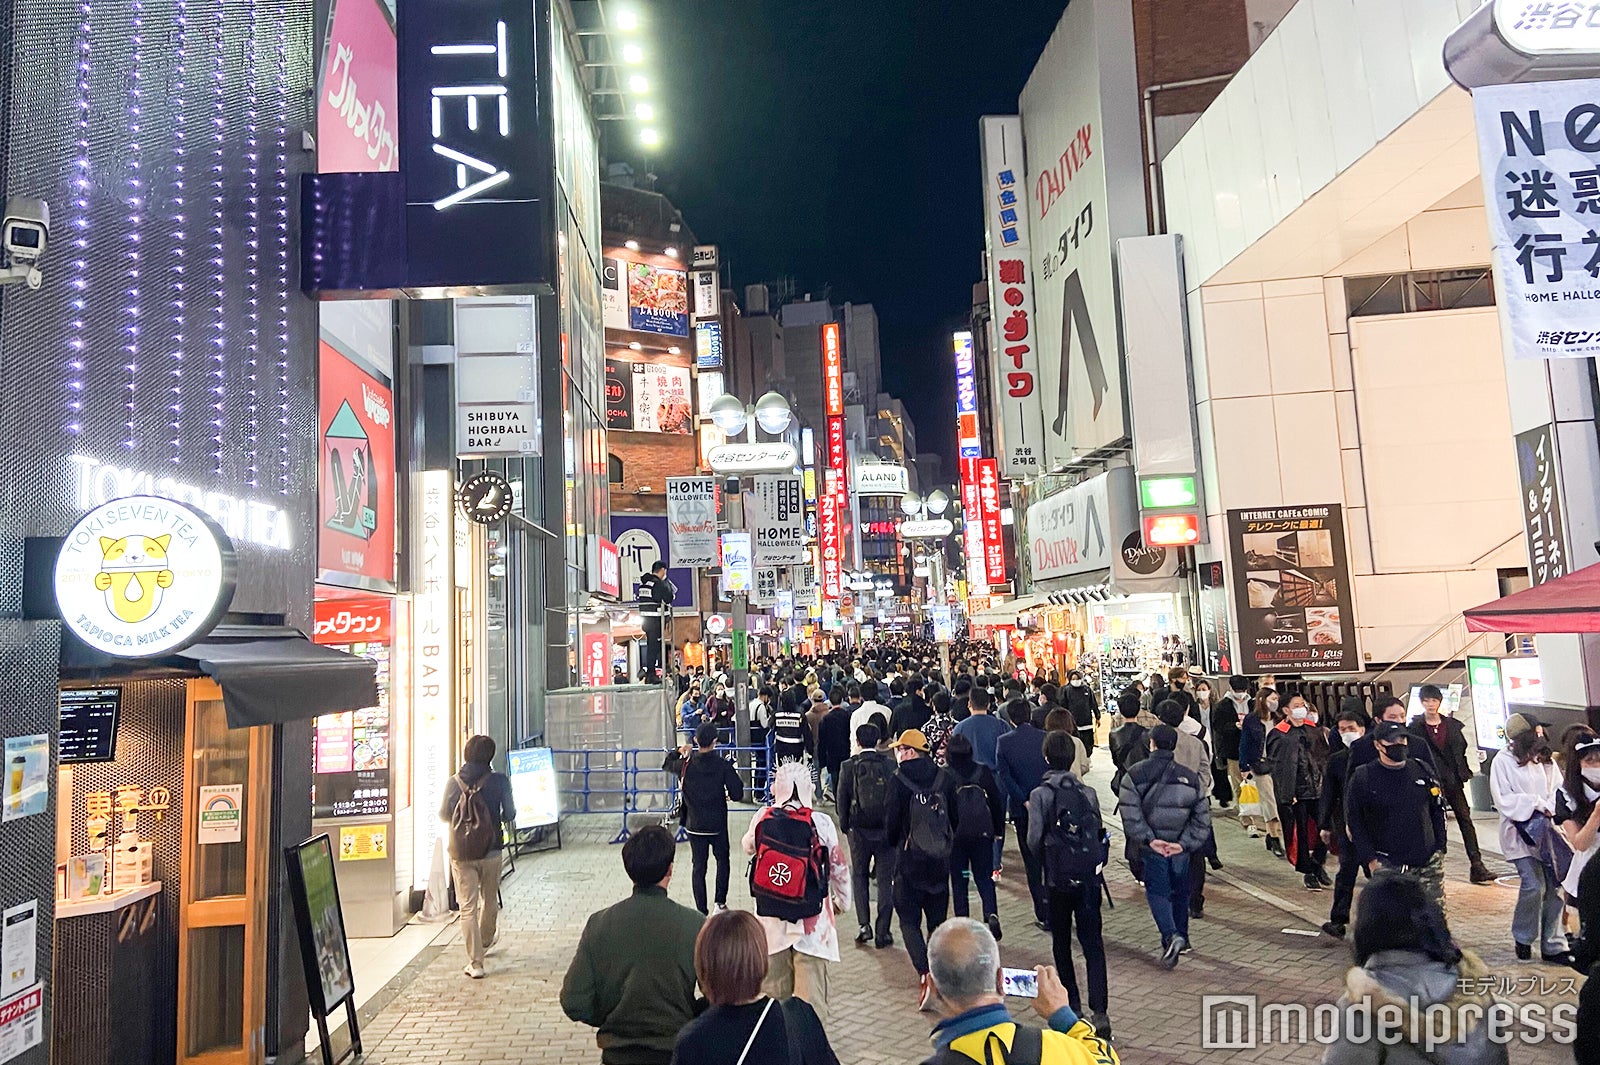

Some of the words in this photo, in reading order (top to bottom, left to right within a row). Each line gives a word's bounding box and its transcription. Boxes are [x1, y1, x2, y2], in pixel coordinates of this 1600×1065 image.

[430, 21, 510, 210] TEA
[468, 412, 519, 421] SHIBUYA
[468, 425, 528, 434] HIGHBALL
[468, 438, 492, 447] BAR
[1015, 448, 1032, 456] 渋谷
[1012, 457, 1037, 466] 2号店
[1240, 510, 1276, 521] INTERNET
[1277, 508, 1329, 518] CAFE&COMIC
[67, 517, 104, 555] TOKI
[106, 505, 169, 525] SEVEN
[169, 514, 199, 549] TEA
[989, 557, 1001, 566] 3F
[75, 614, 133, 647] TAPIOCA
[136, 627, 171, 646] MILK
[169, 609, 194, 630] TEA
